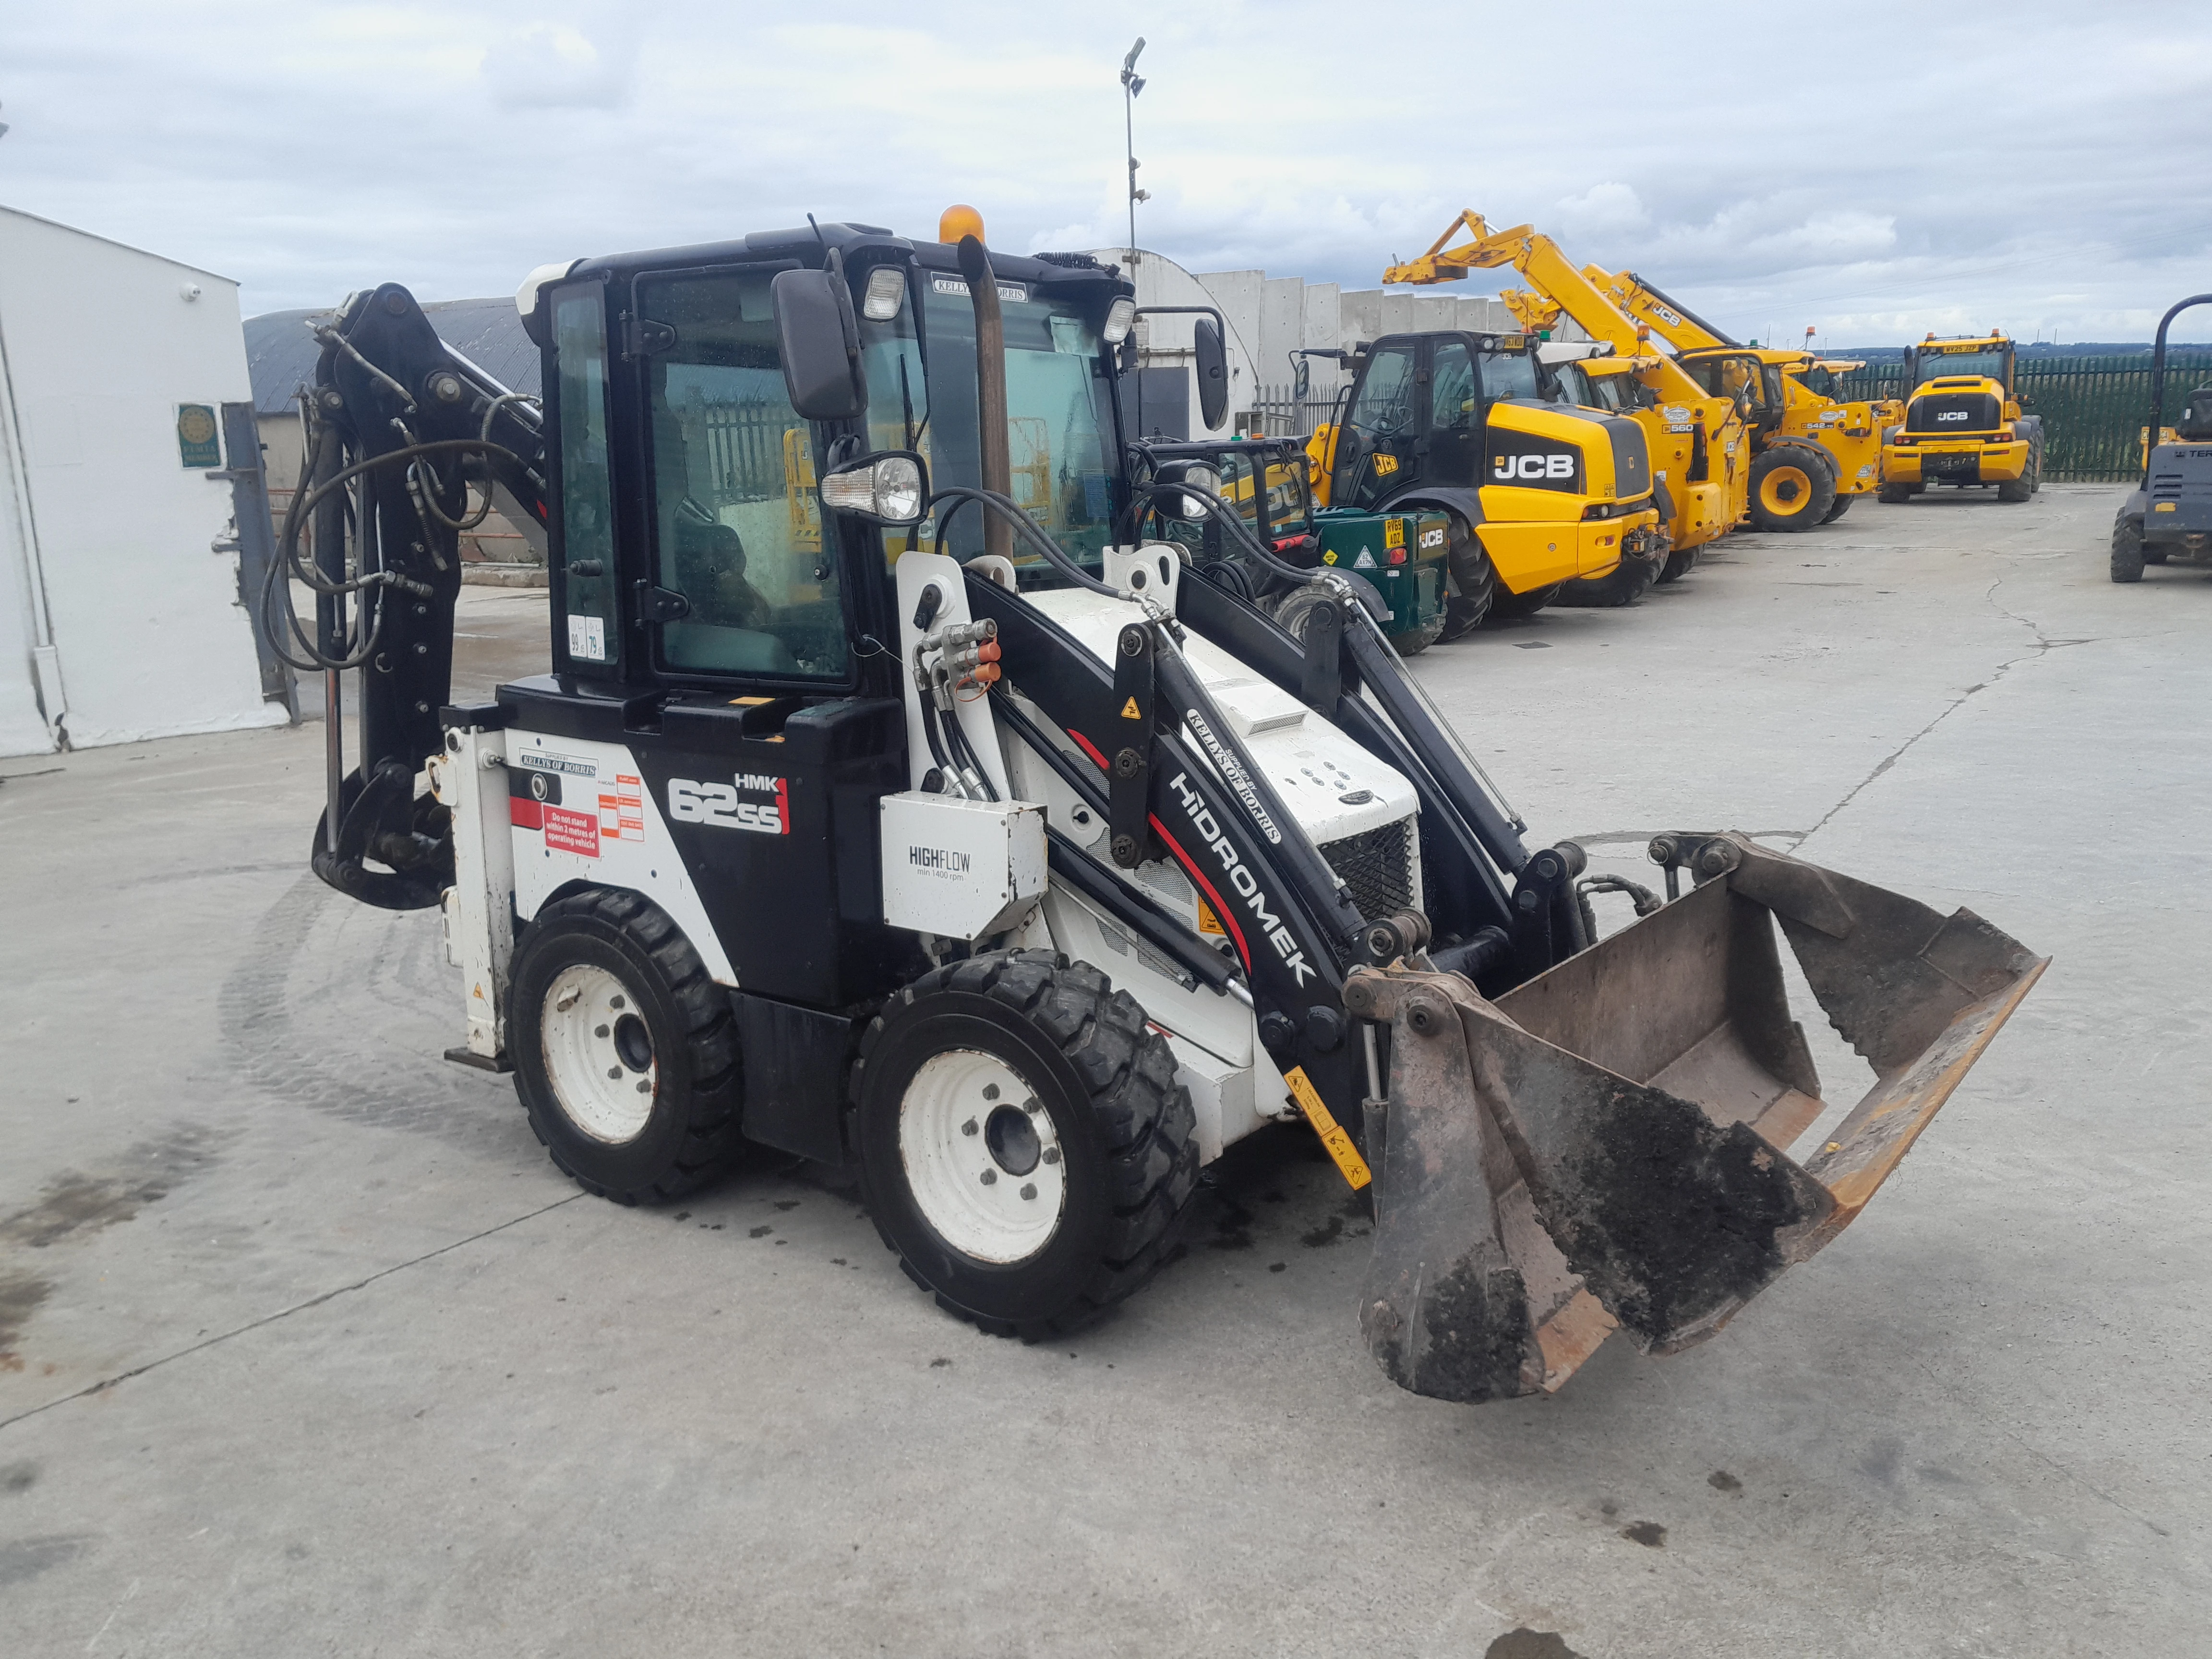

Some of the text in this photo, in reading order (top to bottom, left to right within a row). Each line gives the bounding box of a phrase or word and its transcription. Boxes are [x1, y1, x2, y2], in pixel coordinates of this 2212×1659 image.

[938, 280, 1023, 300] KELLY ORRIS
[1653, 306, 1681, 327] JCB
[1937, 411, 1968, 421] JCB
[1377, 456, 1396, 473] JCB
[1495, 455, 1574, 479] JCB
[1387, 519, 1402, 533] RV69
[1390, 532, 1401, 545] ADZ
[1421, 529, 1443, 548] JCB
[572, 633, 579, 651] 99
[589, 635, 597, 654] 79
[524, 756, 596, 775] KELLYS OF BORRIS
[735, 772, 780, 792] HMK
[1189, 712, 1280, 840] KELLYS OF BORRIS
[1248, 781, 1257, 790] BY
[552, 812, 588, 828] Do not stand
[546, 821, 596, 840] within 2 metres of
[548, 832, 596, 850] operating vehicle
[909, 845, 971, 873] HIGHFLOW
[917, 867, 964, 882] min 1400 rpm
[1169, 771, 1317, 989] HIDROMEK
